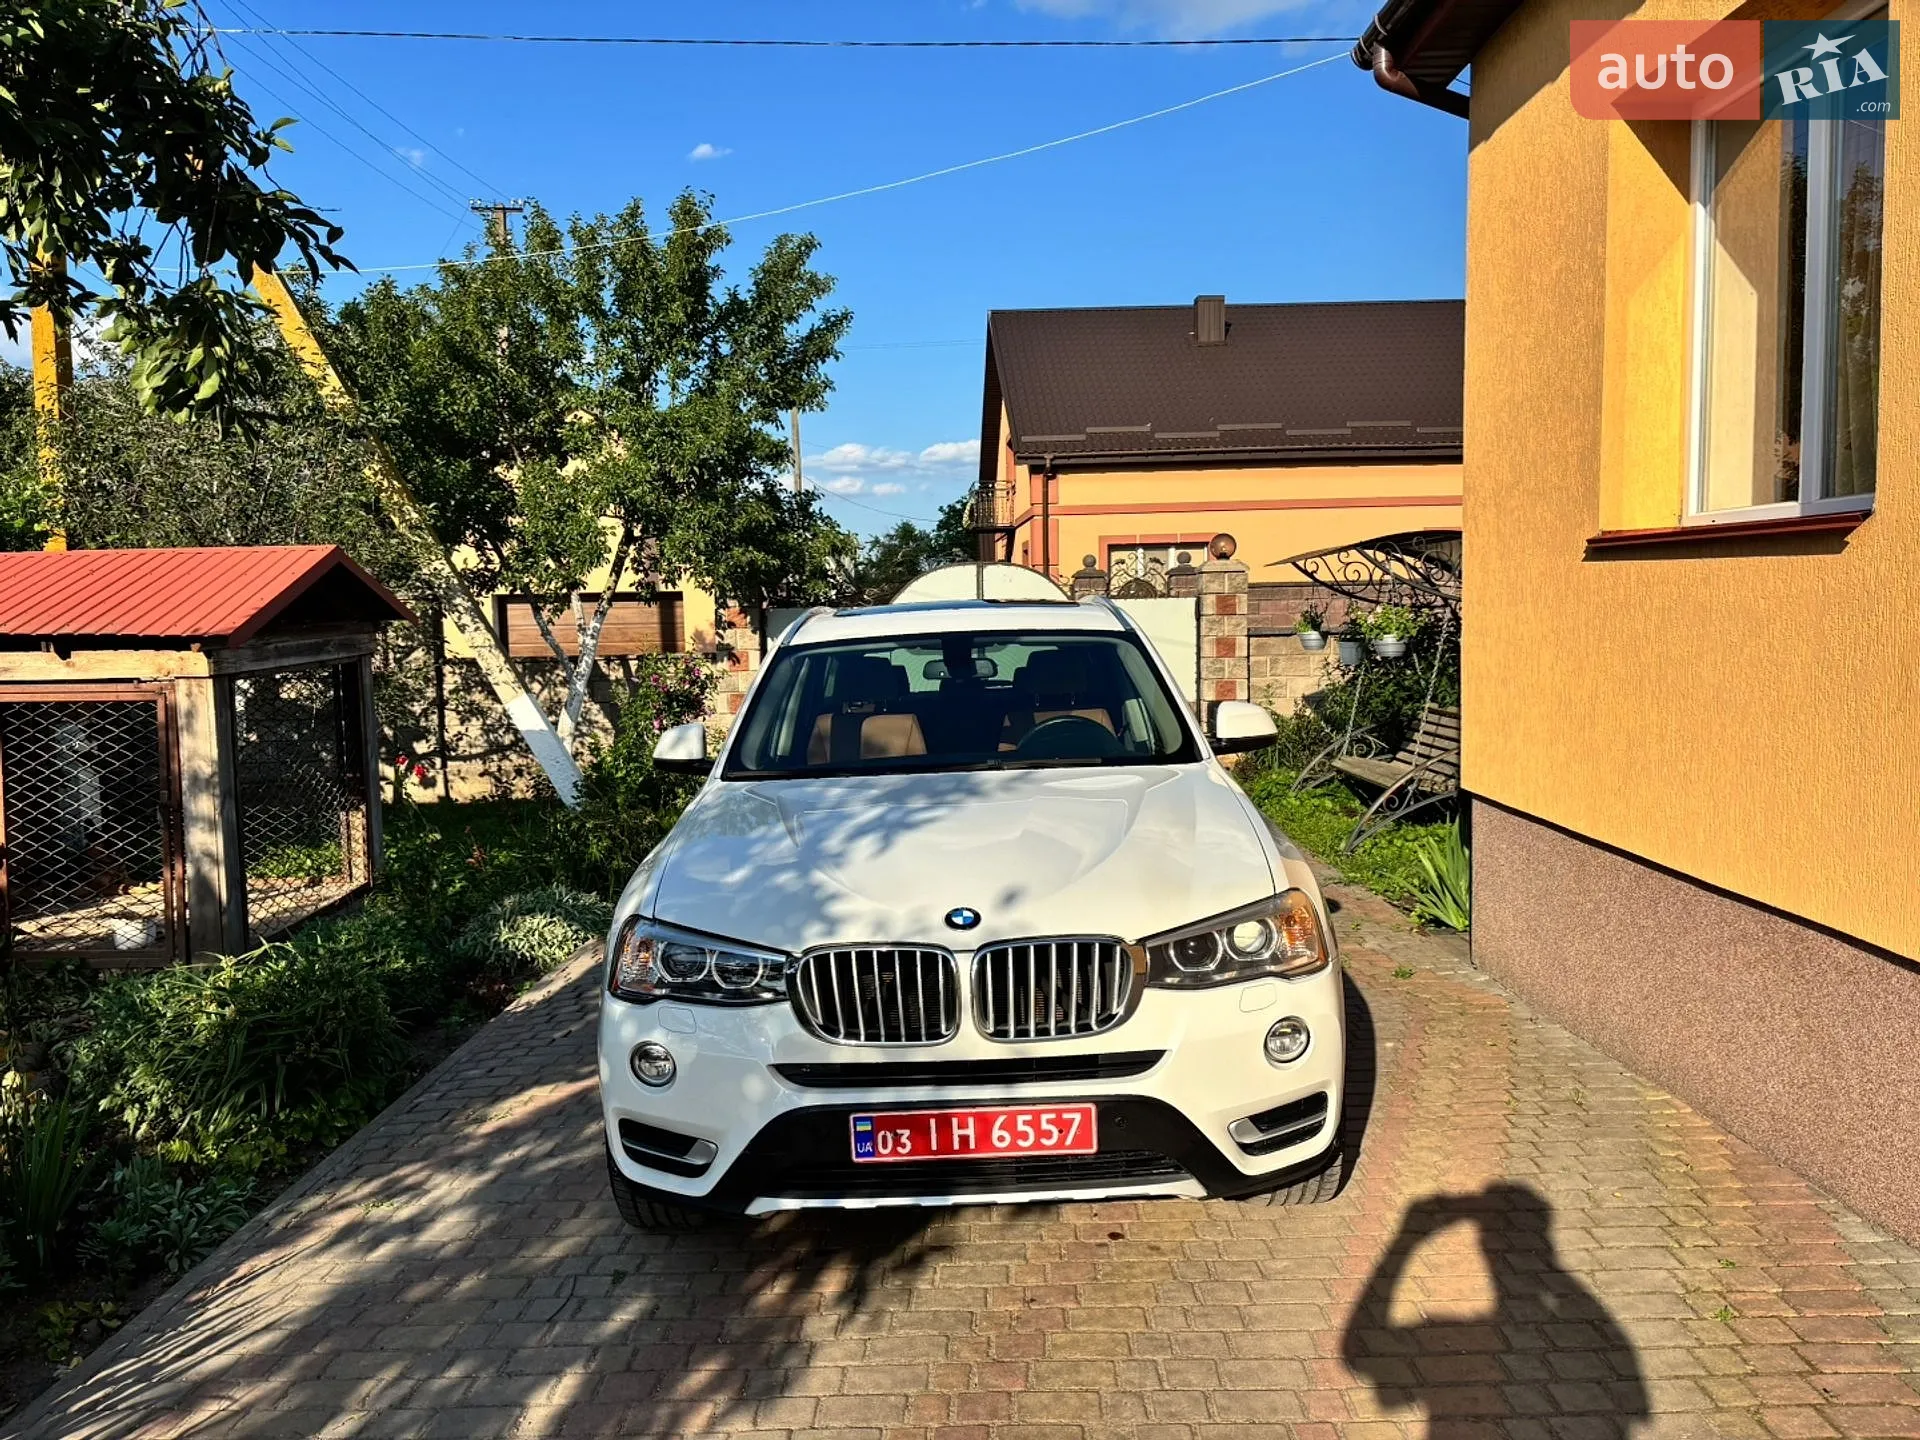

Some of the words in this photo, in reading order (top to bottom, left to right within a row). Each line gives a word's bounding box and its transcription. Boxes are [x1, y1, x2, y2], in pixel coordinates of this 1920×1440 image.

[877, 1129, 912, 1154] 03
[991, 1112, 1082, 1148] 6557
[857, 1142, 873, 1154] UA
